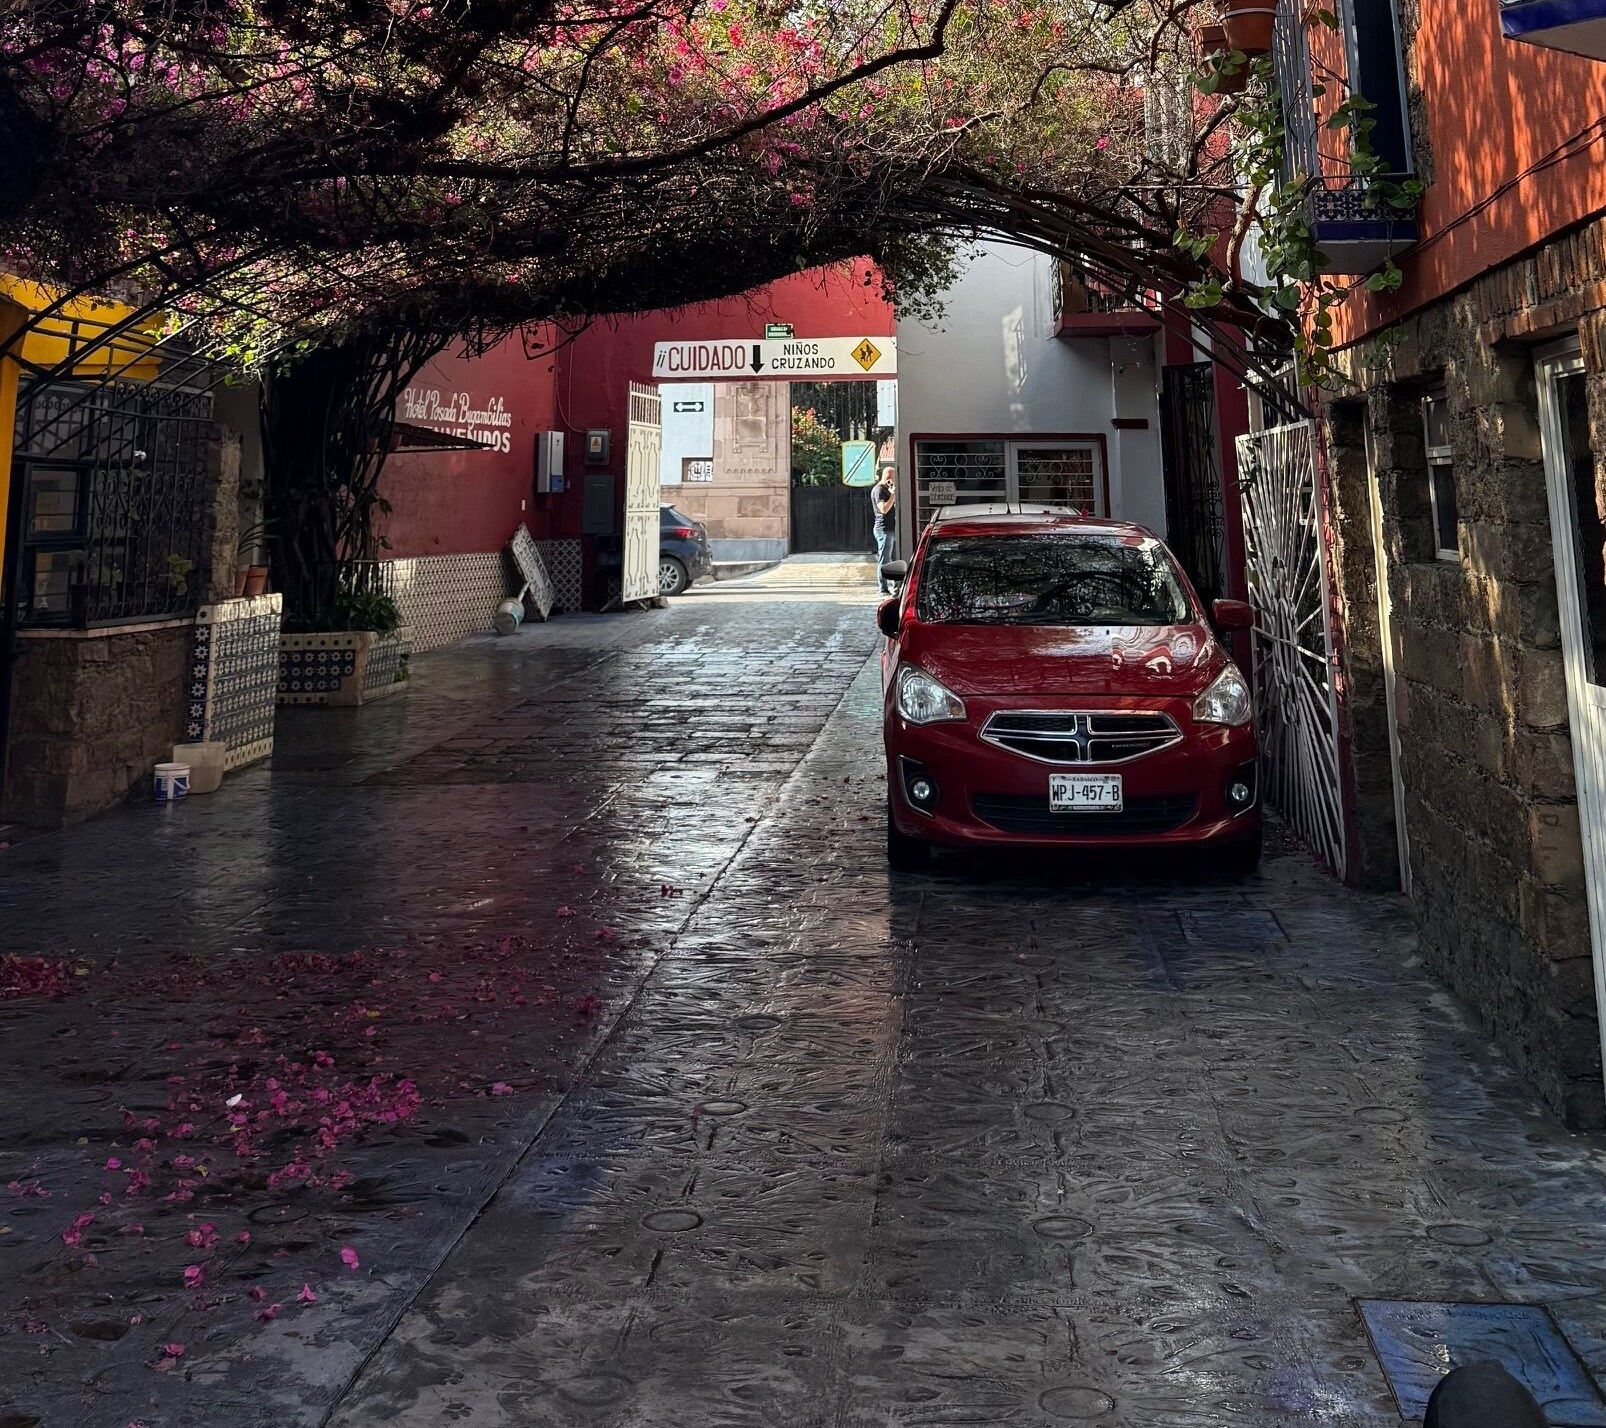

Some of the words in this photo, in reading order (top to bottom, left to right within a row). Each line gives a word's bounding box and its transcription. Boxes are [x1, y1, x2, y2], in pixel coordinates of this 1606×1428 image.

[783, 342, 819, 356] NIÑOS
[771, 357, 835, 370] CRUZANDO
[404, 388, 431, 420] Hotel
[430, 389, 458, 422] Posada
[459, 392, 512, 431] Bugambilias
[1051, 784, 1120, 802] WPJ-457-B
